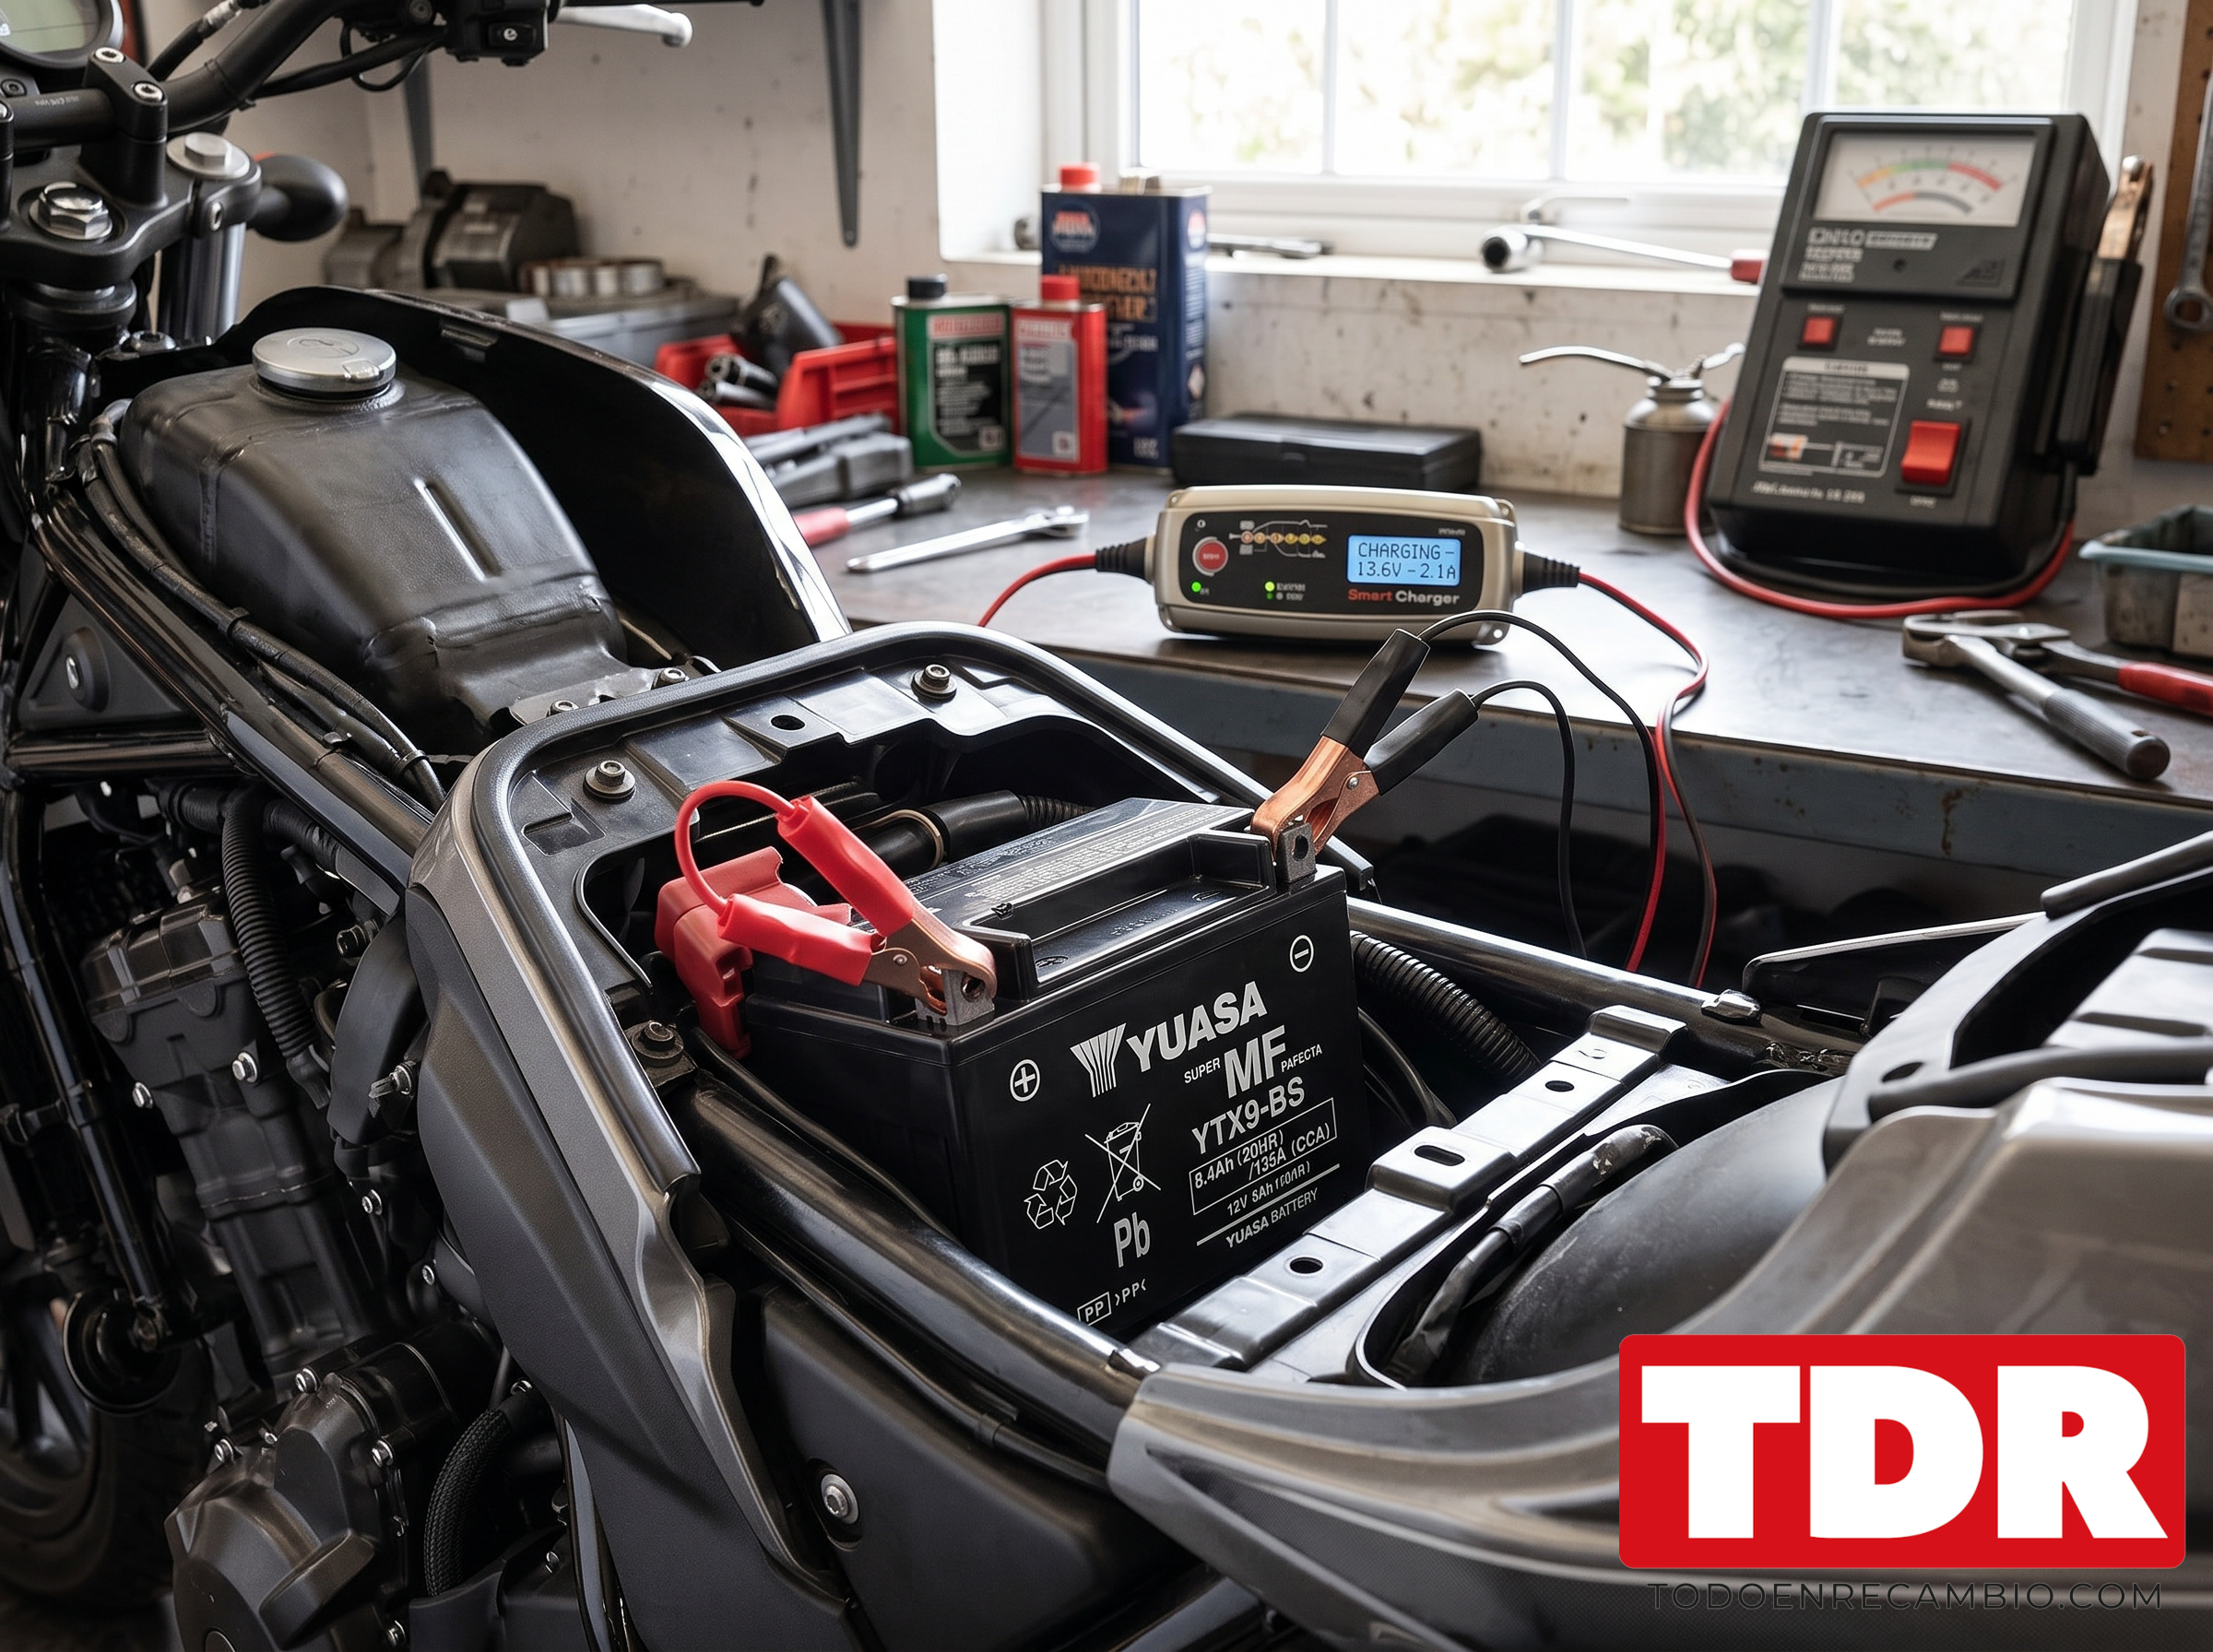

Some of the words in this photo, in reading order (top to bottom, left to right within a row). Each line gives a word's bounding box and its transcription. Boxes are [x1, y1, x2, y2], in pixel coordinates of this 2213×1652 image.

[1358, 542, 1440, 560] CHARGING
[1358, 561, 1402, 577] 13.6V
[1420, 563, 1456, 580] 2.1A
[1347, 589, 1392, 601] Smart
[1395, 590, 1460, 607] Charger
[1126, 981, 1268, 1072] YUASA
[1184, 1057, 1221, 1084] SUPER
[1224, 1024, 1286, 1099] MF
[1281, 1044, 1323, 1072] PAFECTA
[1191, 1076, 1305, 1154] YTX9-BS
[1195, 1157, 1234, 1189] 8.4Ah
[1237, 1129, 1284, 1166] (20HR)
[1249, 1148, 1286, 1180] /135A
[1292, 1122, 1330, 1156] (CCA)
[1225, 1216, 1269, 1248] YUASA
[1271, 1187, 1318, 1223] BATTERY
[1227, 1194, 1248, 1216] 12V
[1114, 1211, 1151, 1268] Pb
[1085, 1301, 1104, 1322] PP
